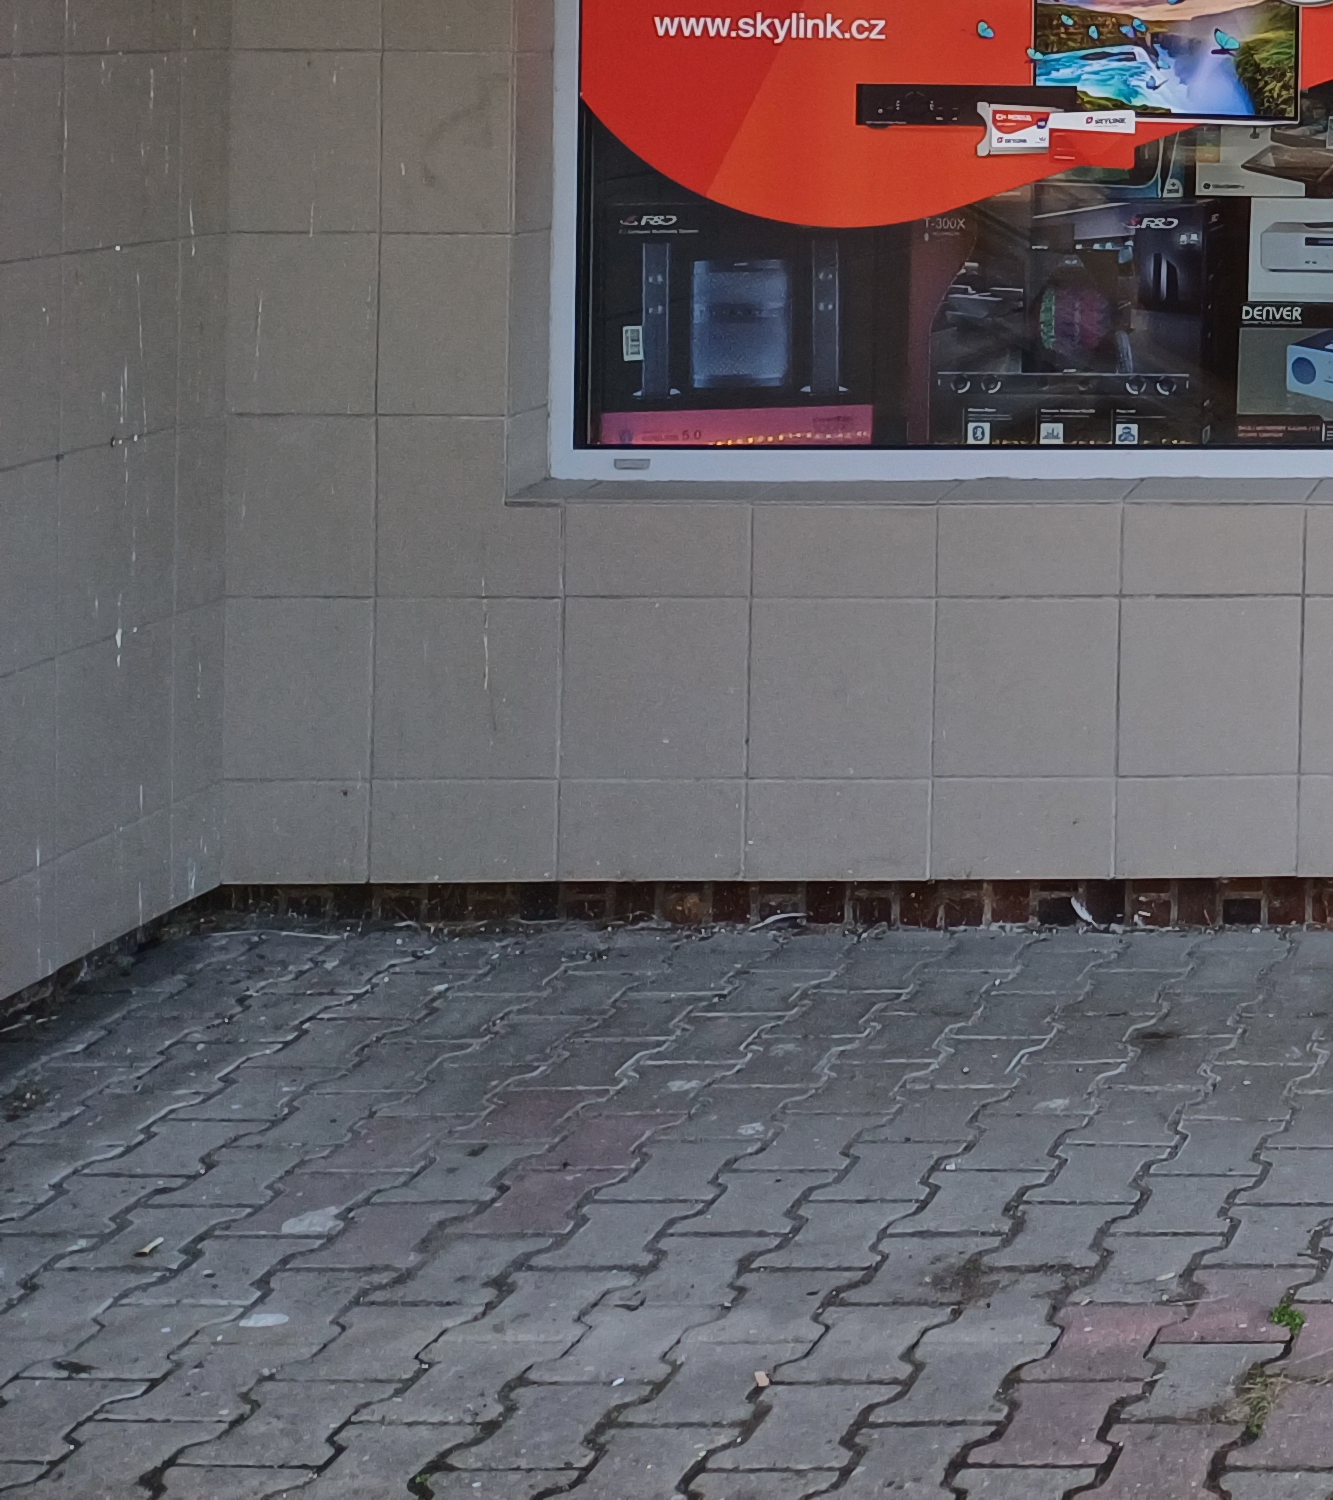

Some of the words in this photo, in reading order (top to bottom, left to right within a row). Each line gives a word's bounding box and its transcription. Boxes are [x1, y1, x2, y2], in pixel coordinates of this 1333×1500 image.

[654, 11, 887, 46] www.skylink.cz
[924, 217, 966, 230] T-300X
[1241, 305, 1303, 322] DENVER
